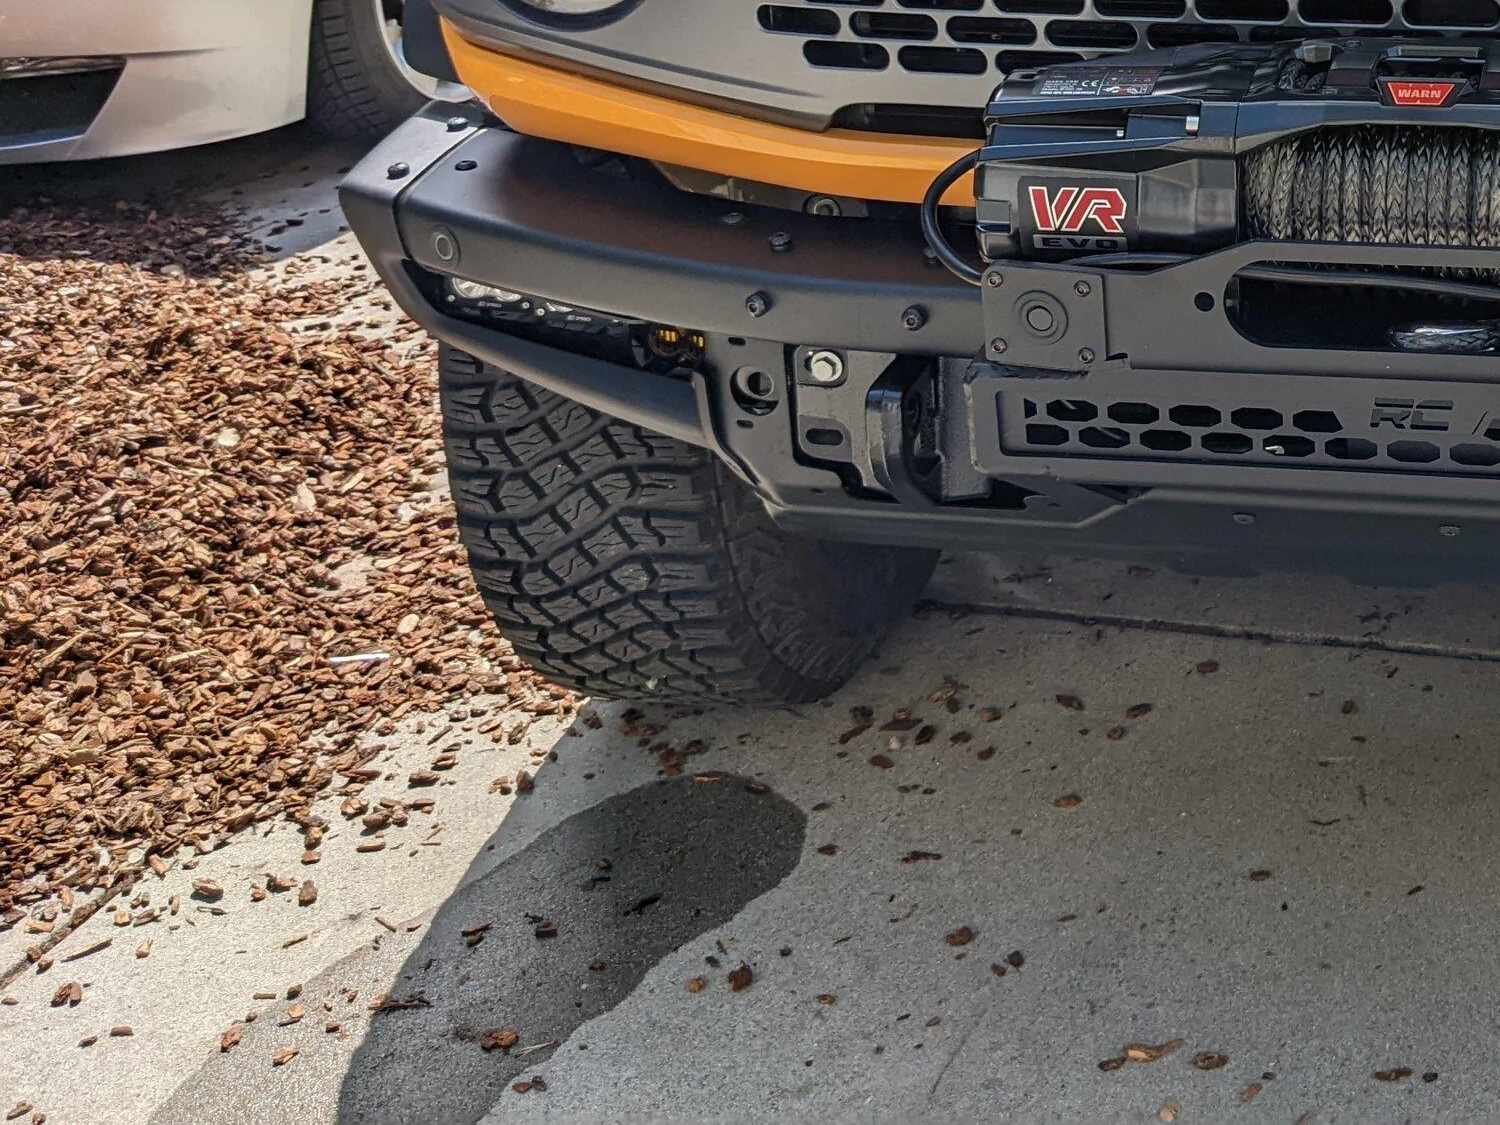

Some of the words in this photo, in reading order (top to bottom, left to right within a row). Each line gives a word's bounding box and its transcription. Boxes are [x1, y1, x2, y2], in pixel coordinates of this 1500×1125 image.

[1398, 89, 1442, 98] WARN
[1028, 186, 1127, 233] VR
[1042, 237, 1119, 249] EVO
